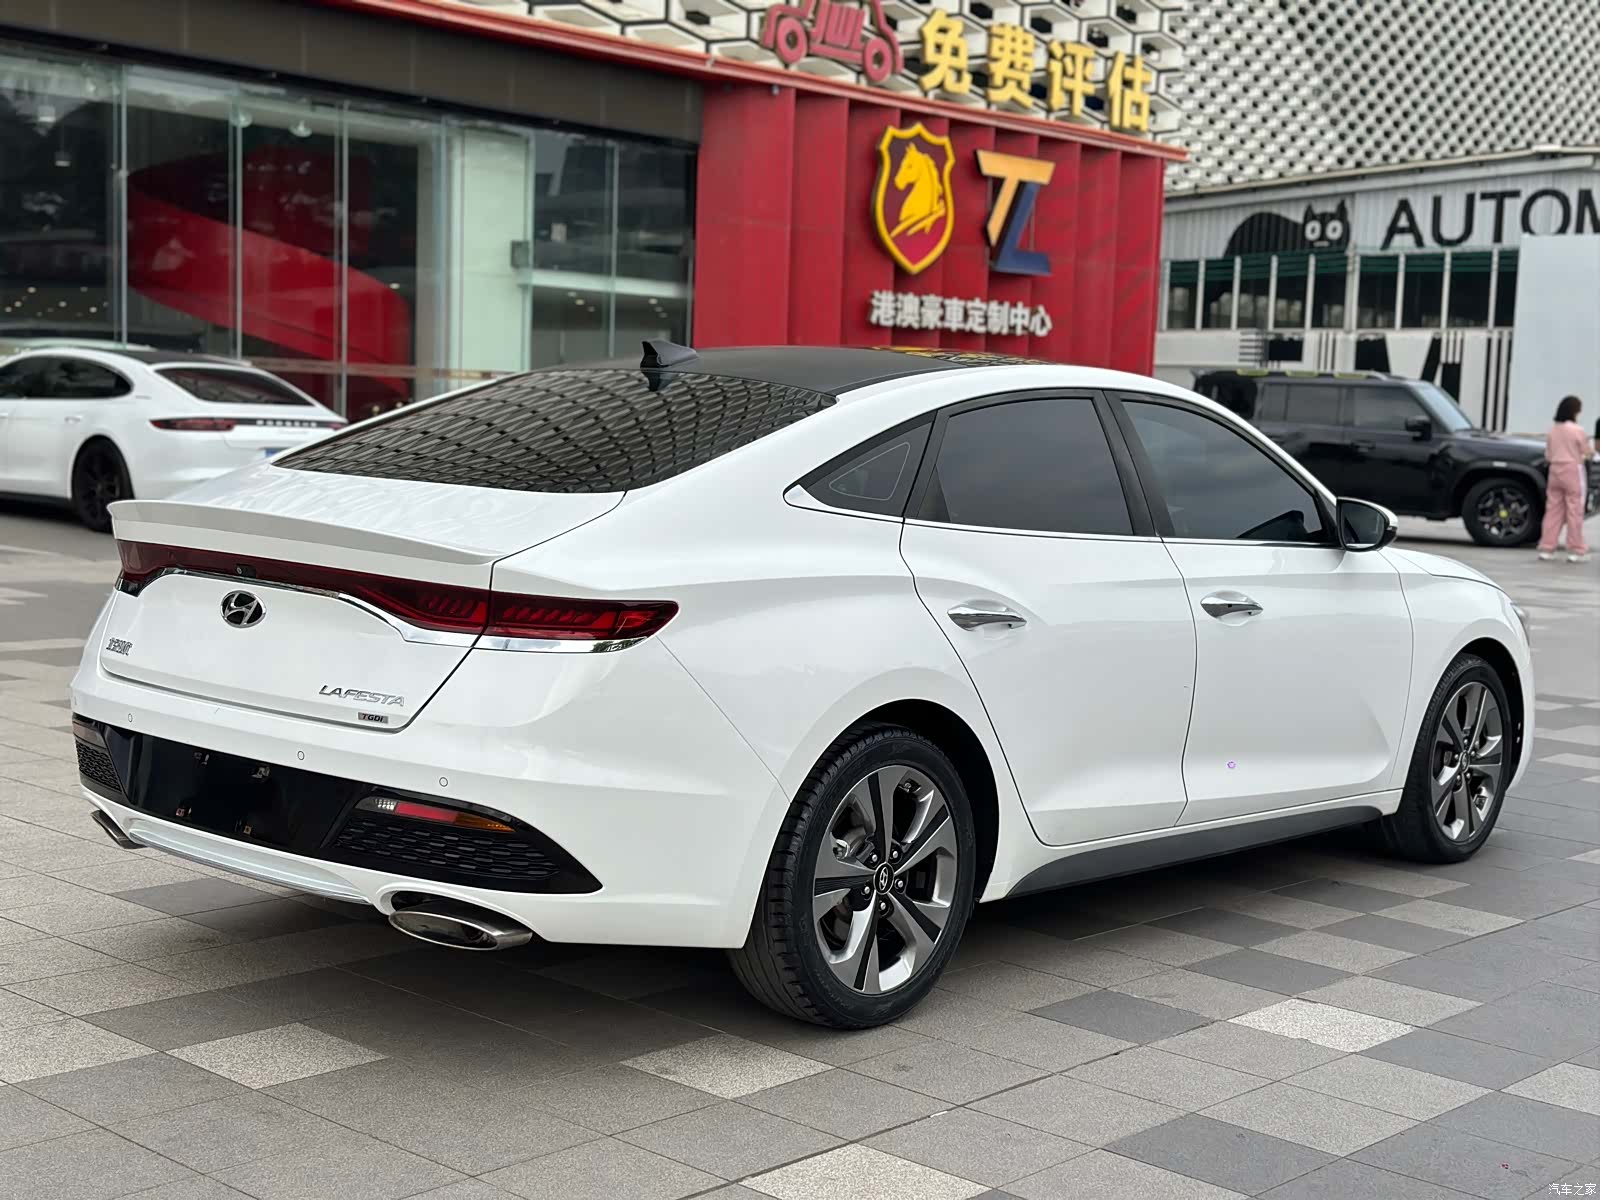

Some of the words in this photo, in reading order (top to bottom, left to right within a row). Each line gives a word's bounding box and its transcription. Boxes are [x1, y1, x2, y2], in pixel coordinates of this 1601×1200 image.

[920, 8, 1152, 131] 免费评估
[870, 290, 1052, 336] 港澳豪車定制中心
[319, 685, 405, 707] LAFESTA
